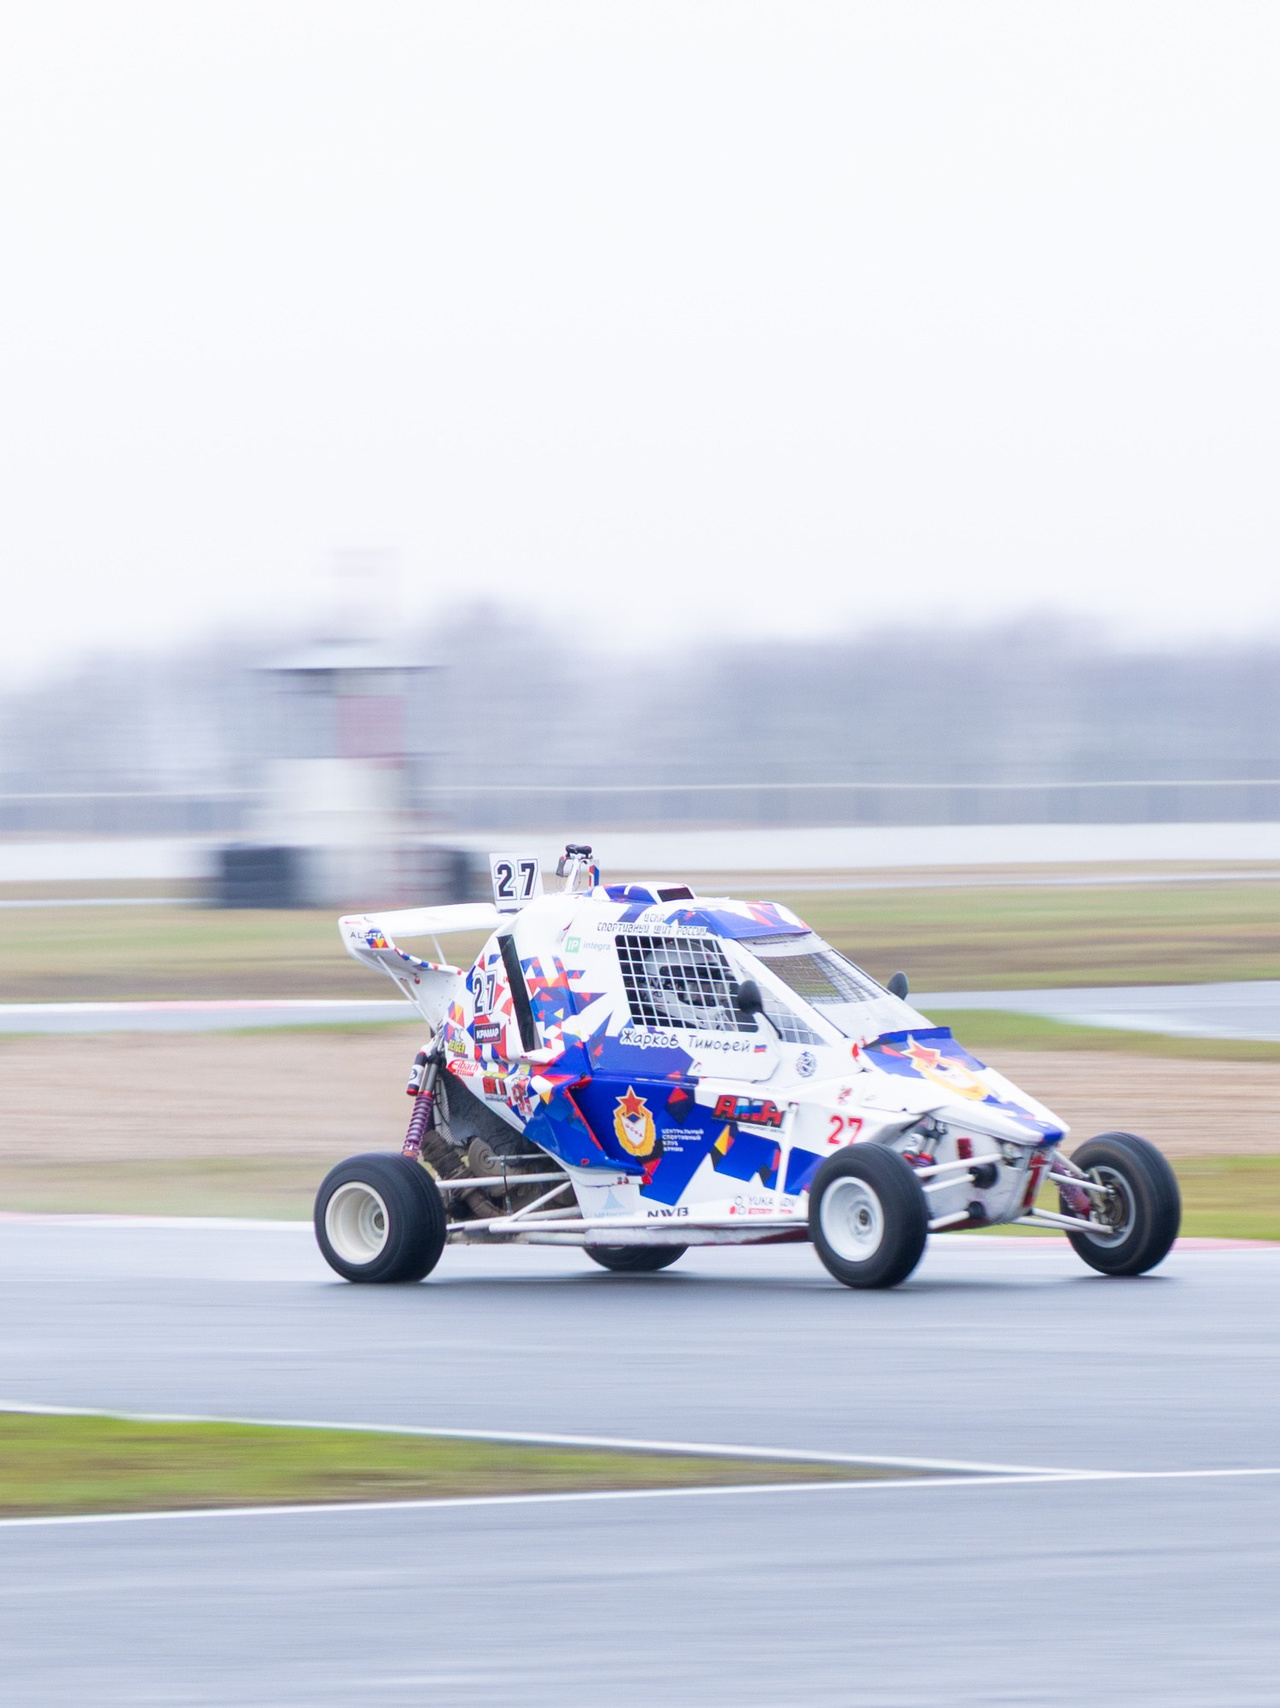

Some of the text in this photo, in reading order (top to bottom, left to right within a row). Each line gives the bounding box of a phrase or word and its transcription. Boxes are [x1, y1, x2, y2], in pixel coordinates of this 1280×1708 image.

[495, 859, 538, 900] 27
[472, 969, 498, 1017] 27
[621, 1030, 750, 1052] Жарков Тимофей
[828, 1115, 863, 1145] 27
